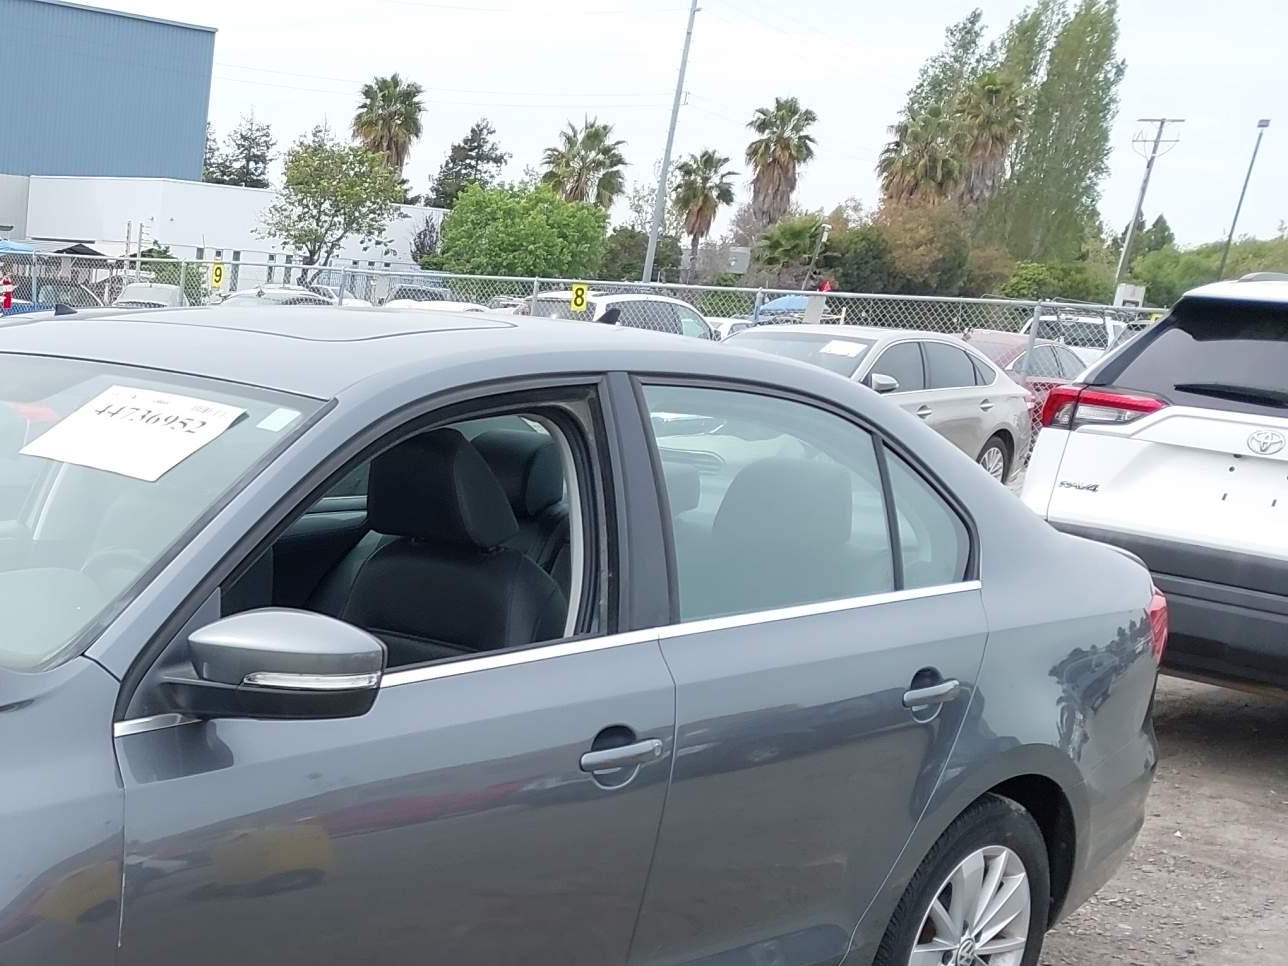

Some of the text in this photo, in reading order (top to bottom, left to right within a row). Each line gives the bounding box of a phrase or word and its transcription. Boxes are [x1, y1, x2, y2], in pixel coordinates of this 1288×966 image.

[214, 266, 222, 283] 9
[573, 287, 585, 307] 8
[94, 403, 208, 434] 44736952
